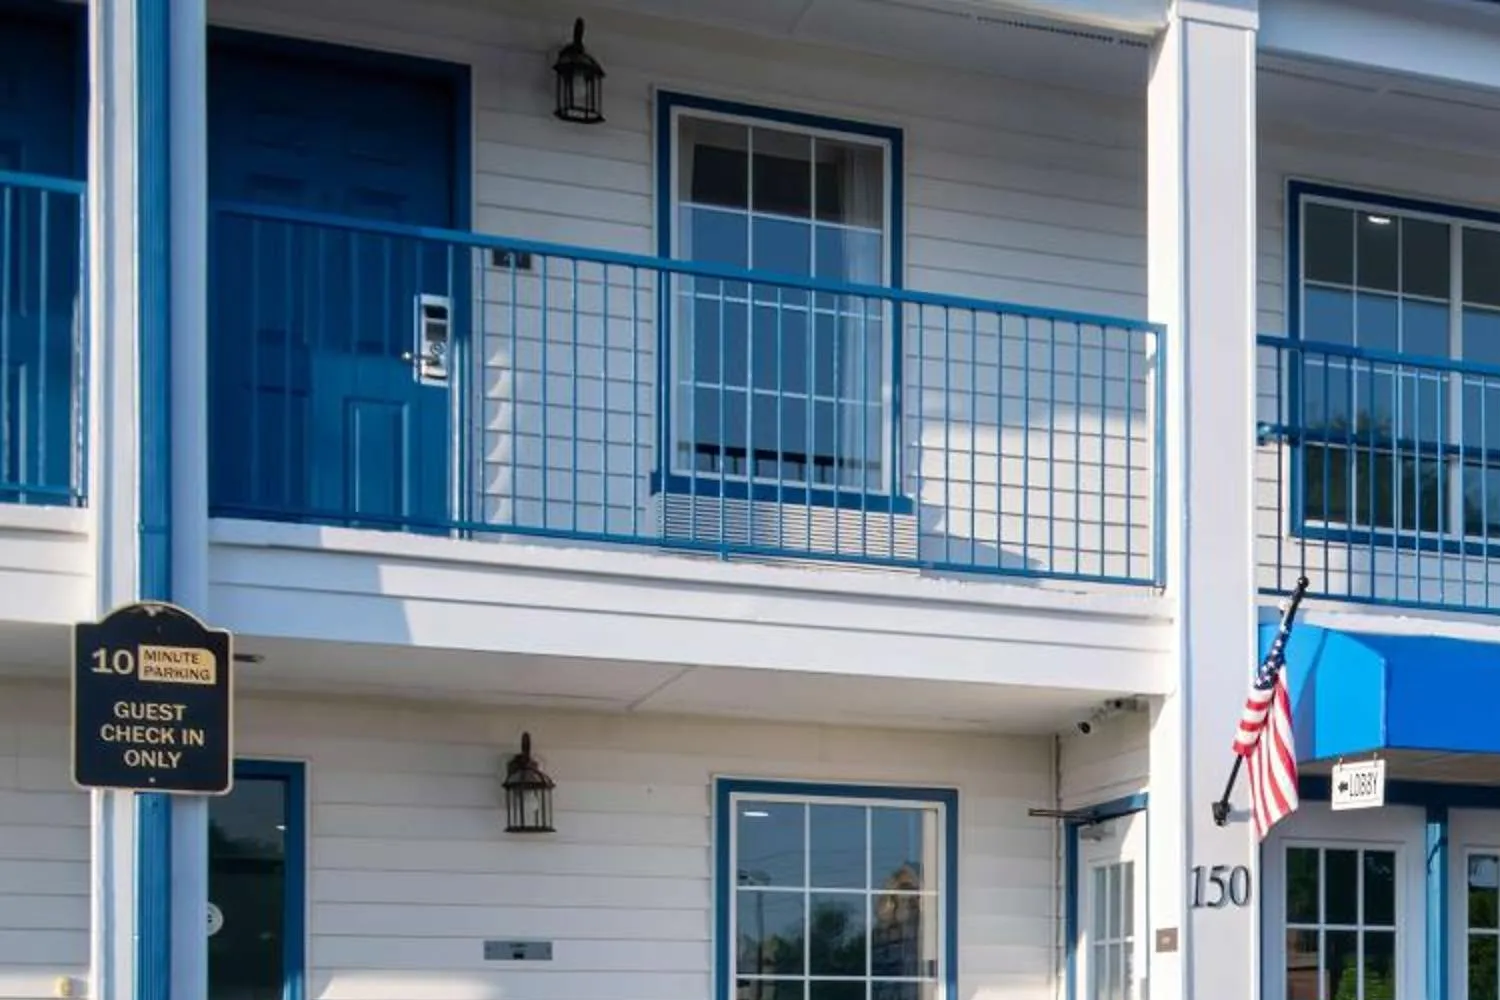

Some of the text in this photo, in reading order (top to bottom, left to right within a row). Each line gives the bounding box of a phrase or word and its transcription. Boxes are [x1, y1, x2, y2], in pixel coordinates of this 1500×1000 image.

[91, 648, 135, 675] 10
[143, 649, 200, 665] MINUTE
[143, 665, 211, 681] PARKING
[113, 701, 188, 721] GUEST
[101, 724, 205, 746] CHECK IN
[123, 749, 183, 769] ONLY
[1349, 771, 1378, 797] LOBBY
[1190, 864, 1251, 910] 150
